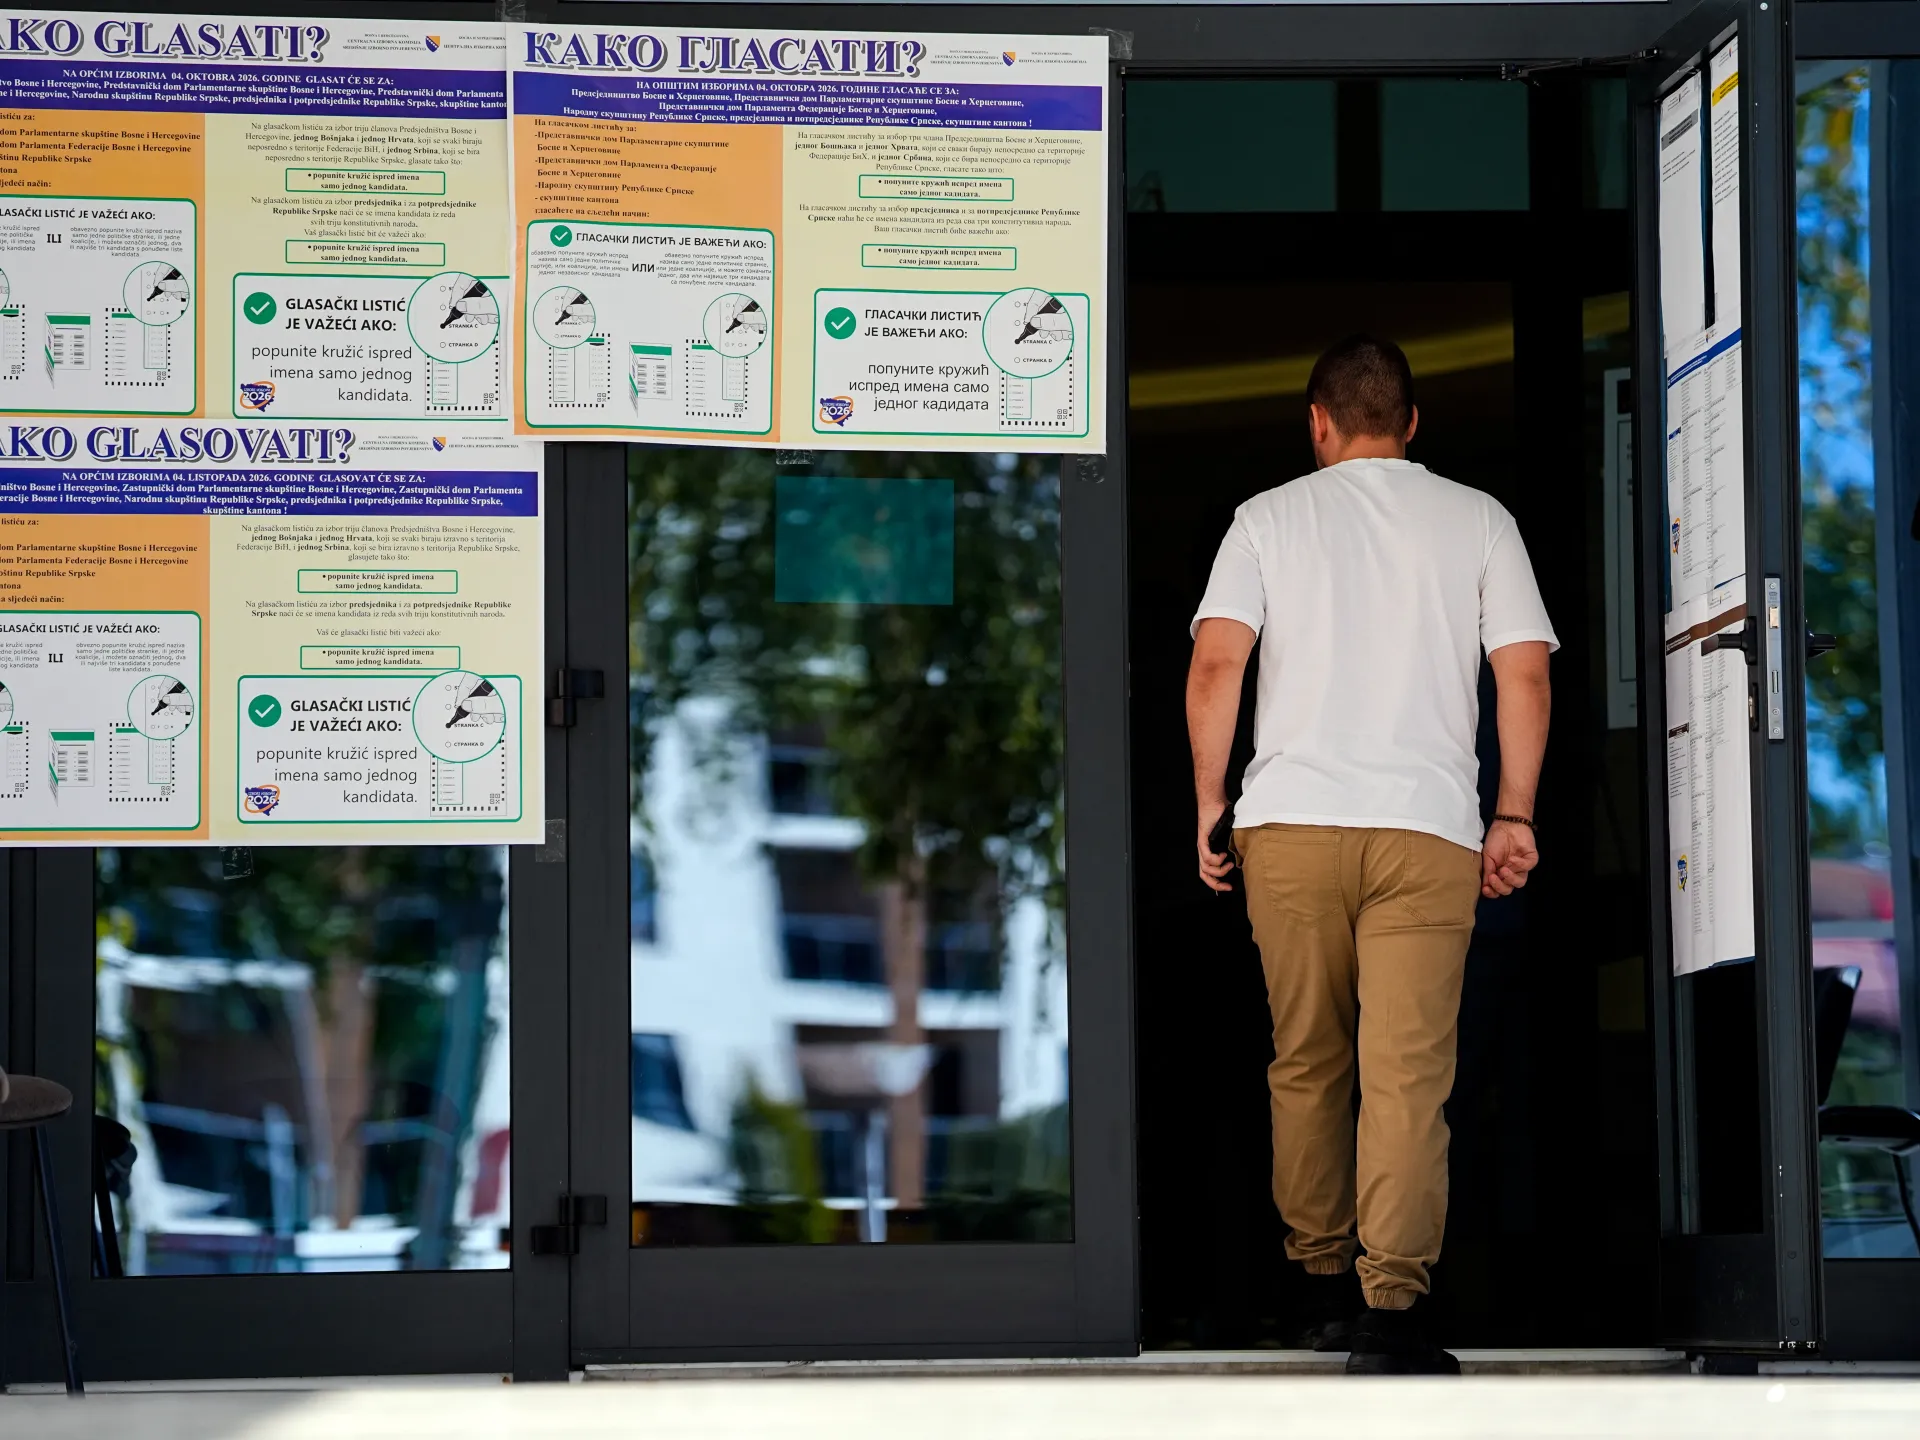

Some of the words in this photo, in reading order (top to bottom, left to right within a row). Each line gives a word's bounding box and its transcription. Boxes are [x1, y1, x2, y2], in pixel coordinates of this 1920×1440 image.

[94, 20, 328, 61] GLASATI?
[522, 31, 667, 70] КАКО
[679, 35, 924, 75] ГЛАСАТИ?
[63, 70, 77, 78] NA
[79, 69, 113, 78] OPĆIM
[116, 71, 167, 80] IZBORIMA
[186, 73, 236, 81] OKTOBRA
[238, 74, 260, 82] 2026.
[262, 75, 302, 83] GODINE
[305, 76, 346, 84] GLASAT
[347, 75, 362, 85] ĆE
[702, 83, 755, 91] ИЗБОРИМА
[841, 86, 880, 94] ГОДИНЕ
[882, 86, 928, 94] ГЛАСАЋЕ
[659, 102, 725, 112] Представнички
[744, 104, 796, 113] Парламента
[798, 105, 846, 114] Федерације
[882, 106, 938, 116] Херцеговине,
[19, 129, 80, 137] Parlamentarne
[81, 131, 119, 139] skupštine
[152, 132, 201, 141] Hercegovine
[372, 173, 396, 181] ispred
[342, 183, 366, 191] jednog
[574, 184, 620, 192] скупштину
[622, 185, 664, 193] Републике
[665, 187, 695, 195] Српске
[263, 197, 300, 206] glasačkom
[354, 199, 402, 207] predsjednika
[418, 201, 477, 209] potpredsjednike
[45, 208, 76, 218] LISTIĆ
[78, 210, 88, 219] JE
[91, 209, 128, 220] VAŽEĆI
[130, 212, 156, 220] AKO:
[46, 234, 62, 244] ILI
[576, 233, 629, 244] ГЛАСАЧКИ
[632, 236, 676, 245] ЛИСТИЋ
[678, 237, 691, 246] ЈЕ
[694, 238, 740, 247] ВАЖЕЋИ
[742, 240, 767, 249] АКО:
[632, 264, 655, 273] ИЛИ
[286, 296, 358, 311] GLASAČKI
[363, 298, 406, 312] LISTIĆ
[865, 310, 927, 320] ГЛАСАЧКИ
[930, 311, 982, 321] ЛИСТИЋ
[285, 318, 301, 330] JE
[304, 316, 357, 330] VAŽEĆI
[361, 320, 397, 331] AKO:
[864, 327, 879, 337] ЈЕ
[882, 328, 936, 338] ВАЖЕЋИ
[939, 329, 968, 339] АКО:
[252, 345, 317, 360] popunite
[322, 345, 364, 359] kružić
[369, 346, 412, 362] ispred
[270, 366, 313, 379] imena
[319, 370, 357, 380] samo
[362, 367, 412, 384] jednog
[868, 365, 934, 378] попуните
[939, 364, 989, 378] кружић
[850, 382, 900, 394] испред
[904, 383, 949, 393] имена
[954, 384, 990, 393] само
[243, 391, 272, 401] 2026
[338, 388, 412, 402] kandidata.
[822, 405, 850, 416] 2026
[874, 398, 919, 412] једног
[923, 400, 989, 412] кадидата
[86, 426, 354, 463] GLASOVATI?
[62, 472, 78, 481] NA
[80, 471, 115, 481] OPĆIM
[117, 473, 171, 481] IZBORIMA
[172, 473, 186, 481] 04.
[188, 474, 247, 482] LISTOPADA
[249, 474, 272, 482] 2026.
[274, 474, 315, 482] GODINE
[319, 474, 376, 483] GLASOVAT
[377, 473, 392, 483] ĆE
[393, 475, 407, 483] SE
[408, 475, 426, 483] ZA:
[328, 573, 360, 582] popunite
[356, 583, 382, 591] jednog
[49, 623, 80, 633] LISTIĆ
[82, 625, 93, 634] JE
[96, 623, 132, 634] VAŽEĆI
[135, 625, 160, 633] AKO:
[340, 629, 369, 638] glasački
[48, 654, 64, 663] ILI
[290, 698, 363, 712] GLASAČKI
[368, 697, 411, 712] LISTIĆ
[290, 720, 305, 732] JE
[309, 717, 362, 732] VAŽEĆI
[366, 720, 402, 732] AKO:
[257, 747, 322, 763] popunite
[328, 747, 368, 760] kružić
[374, 747, 417, 763] ispred
[275, 769, 318, 781] imena
[324, 772, 362, 782] samo
[367, 769, 417, 785] jednog
[247, 794, 276, 805] 2026
[343, 790, 417, 803] kandidata.
